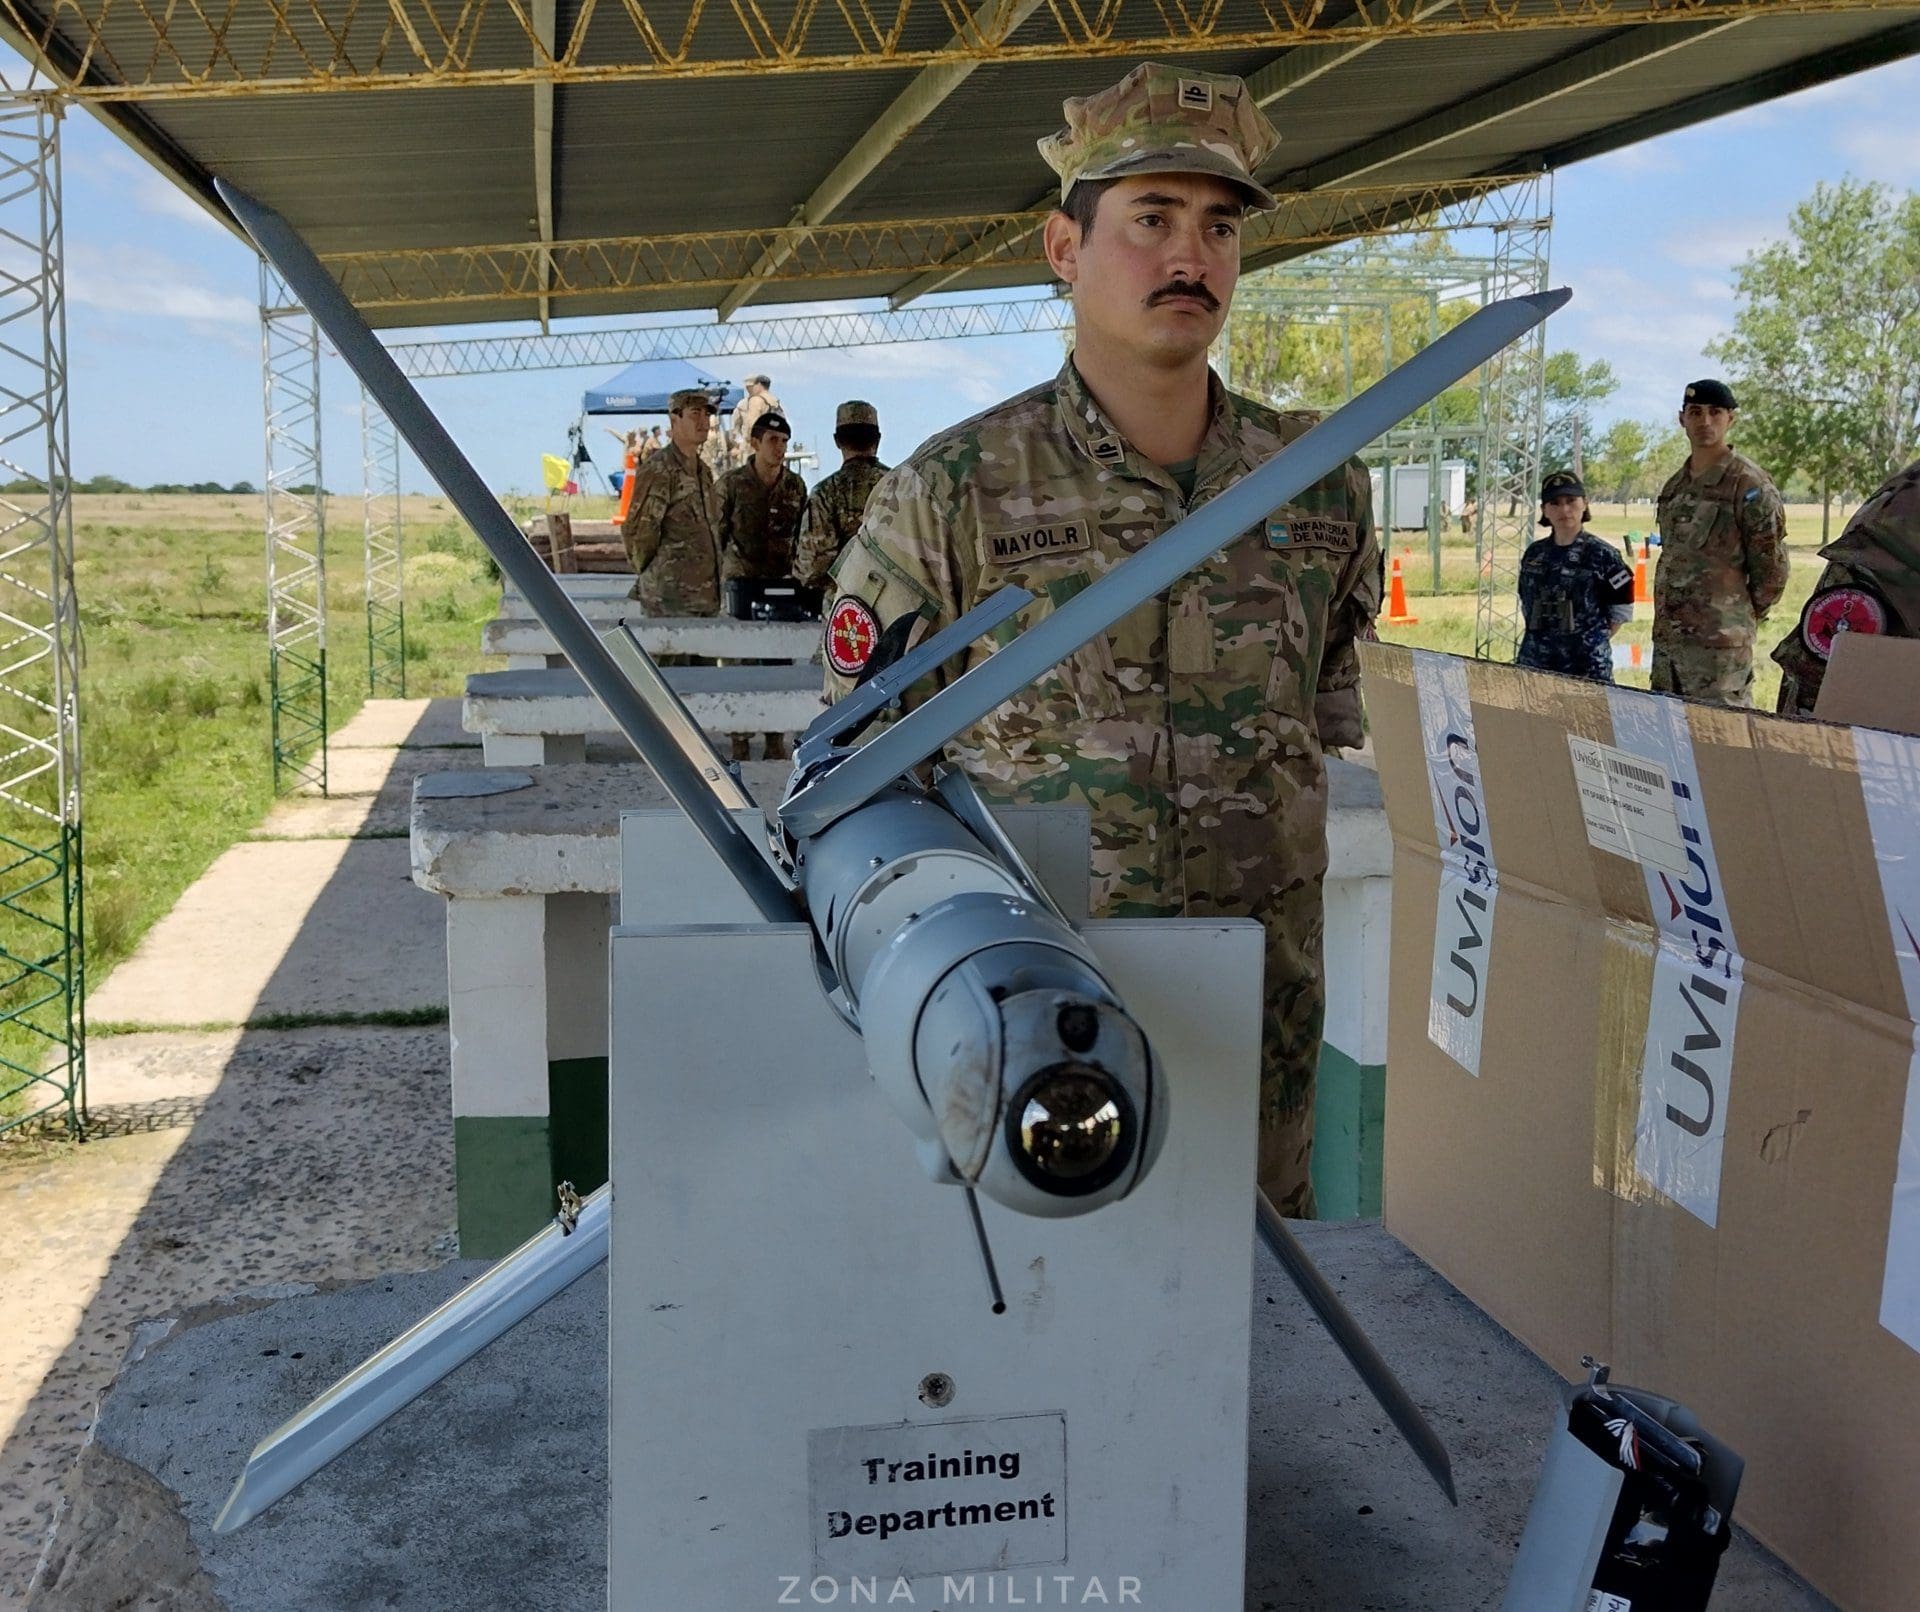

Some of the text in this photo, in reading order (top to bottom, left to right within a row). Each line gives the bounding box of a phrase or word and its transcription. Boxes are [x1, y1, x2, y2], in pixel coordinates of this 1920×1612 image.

[993, 526, 1078, 556] MAYOL.R
[1293, 531, 1312, 543] DE
[861, 1450, 1021, 1485] Training
[827, 1493, 1056, 1540] Department
